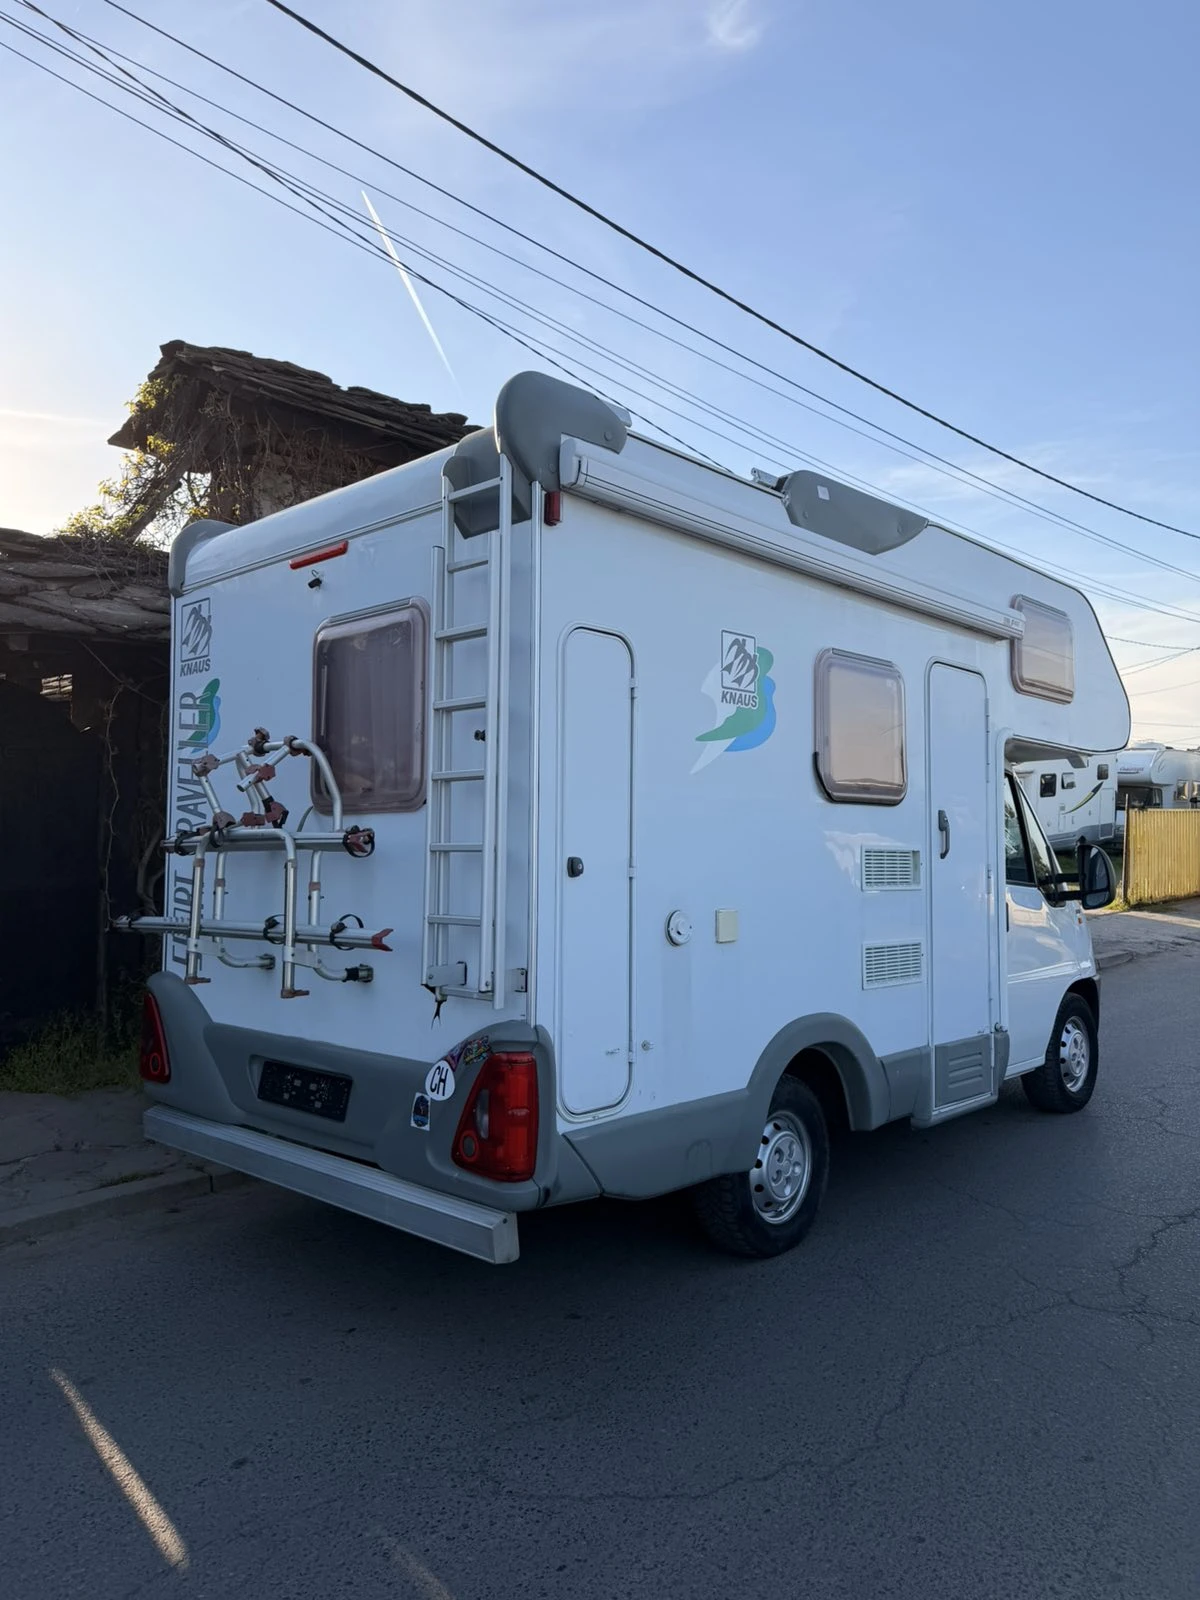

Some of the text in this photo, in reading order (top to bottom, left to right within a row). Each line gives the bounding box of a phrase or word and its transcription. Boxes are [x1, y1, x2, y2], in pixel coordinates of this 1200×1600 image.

[180, 658, 211, 677] KNAUS
[721, 690, 758, 708] KNAUS
[175, 691, 211, 840] RAVELLER
[430, 1065, 449, 1097] CH
